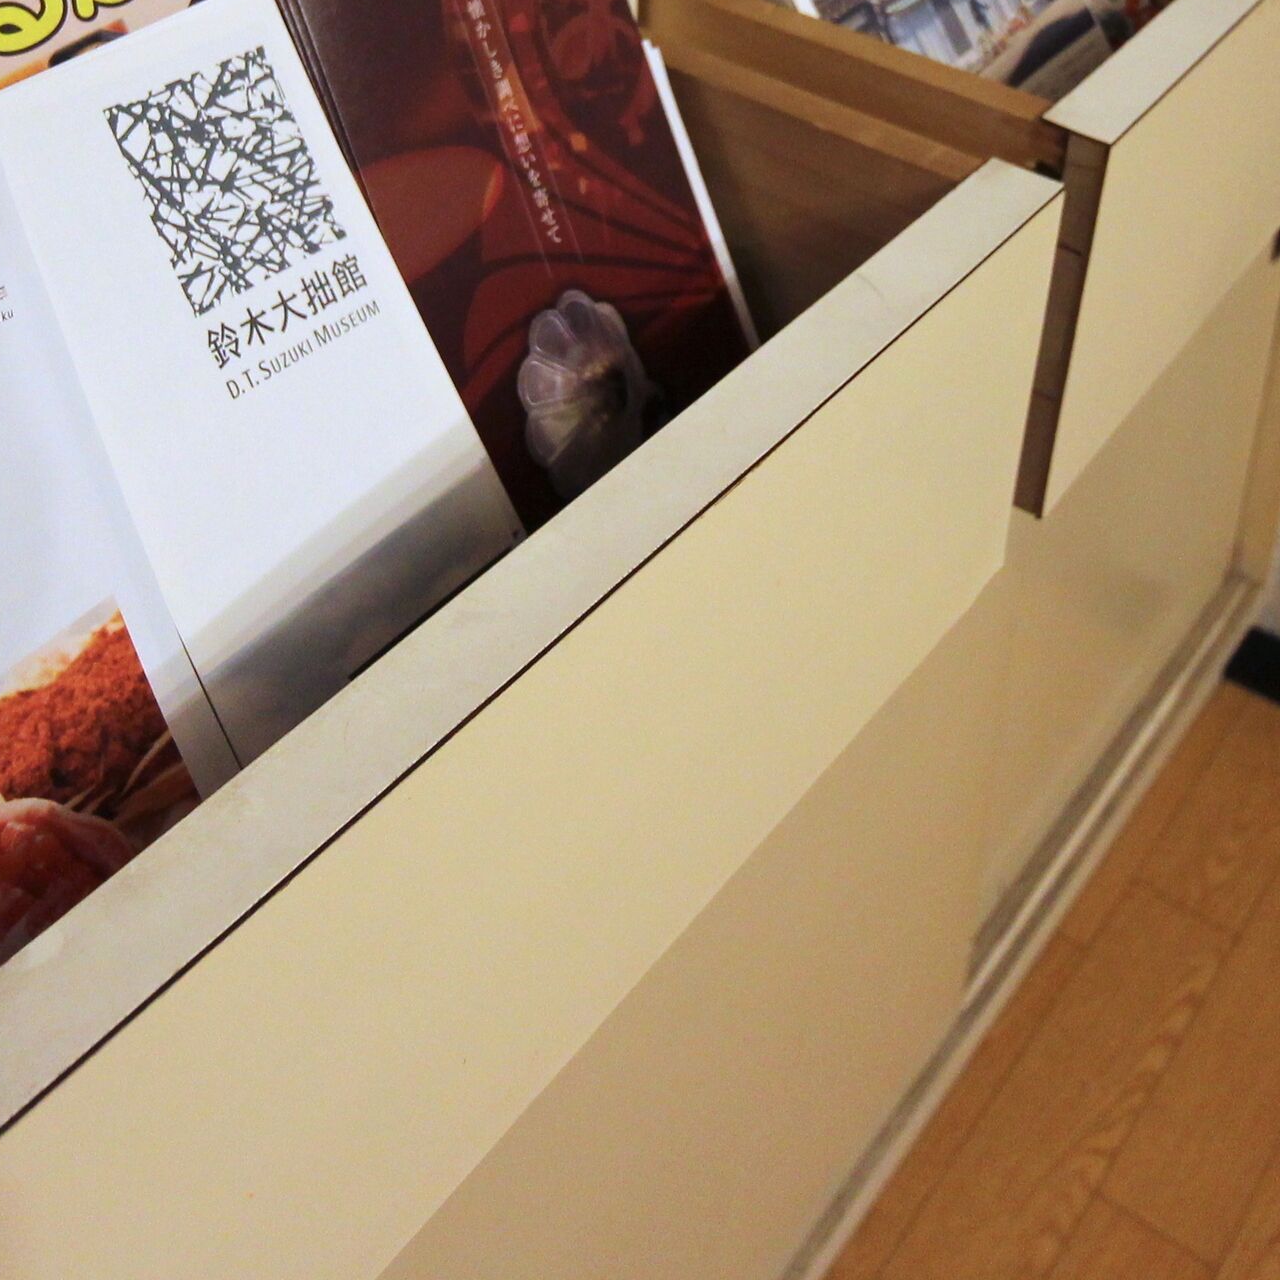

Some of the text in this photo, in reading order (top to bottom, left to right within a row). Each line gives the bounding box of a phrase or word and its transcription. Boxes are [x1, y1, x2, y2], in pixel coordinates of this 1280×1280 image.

[207, 253, 368, 370] 鈴木大拙館
